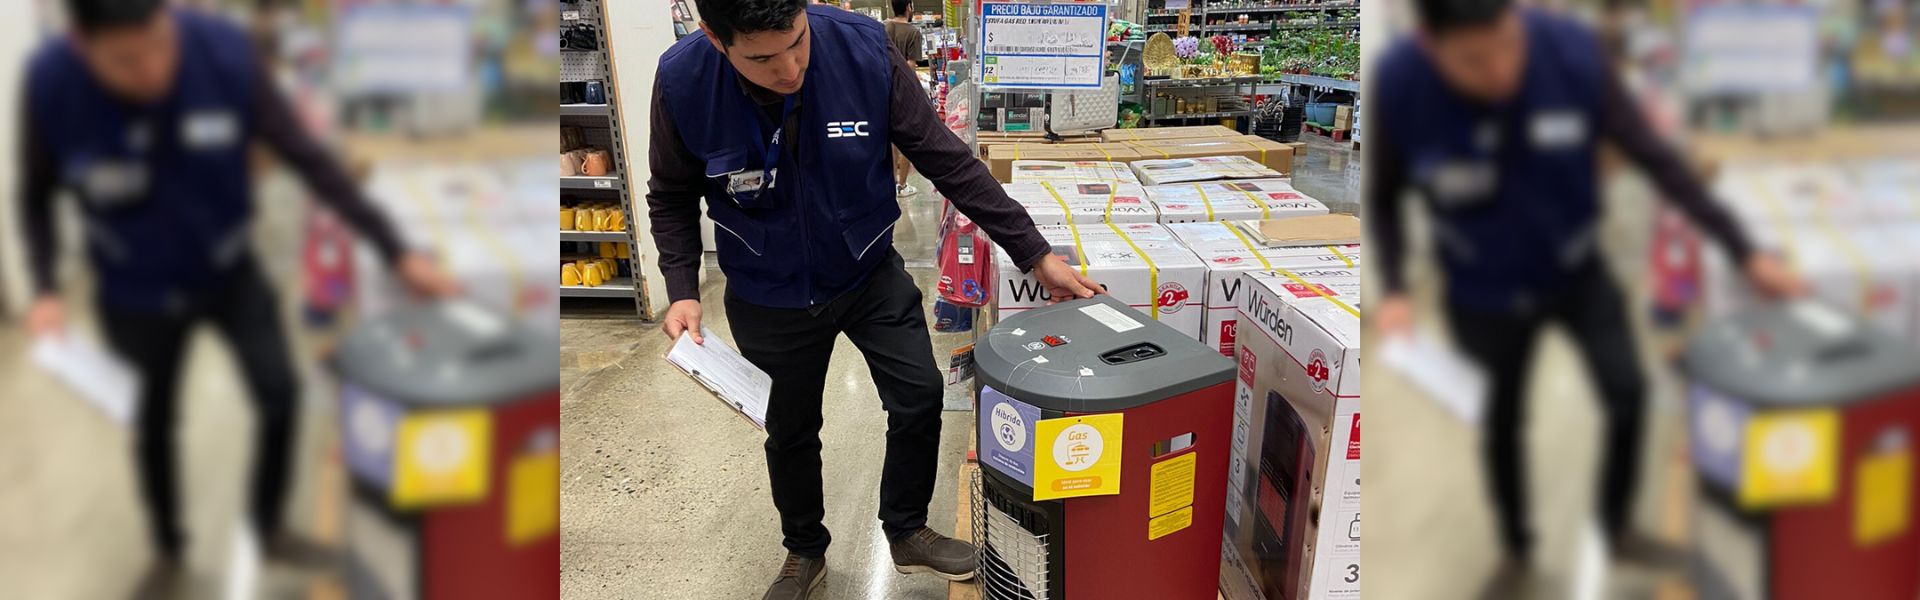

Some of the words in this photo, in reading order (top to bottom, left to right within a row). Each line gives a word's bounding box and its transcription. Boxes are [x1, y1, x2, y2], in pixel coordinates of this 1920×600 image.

[991, 5, 1018, 15] PRECIO
[1020, 5, 1040, 15] BAJO
[1042, 5, 1098, 16] GARANTIZADO
[827, 121, 870, 138] SEC
[1165, 291, 1176, 305] 2
[1068, 431, 1088, 441] Gas
[1344, 563, 1360, 583] 3
